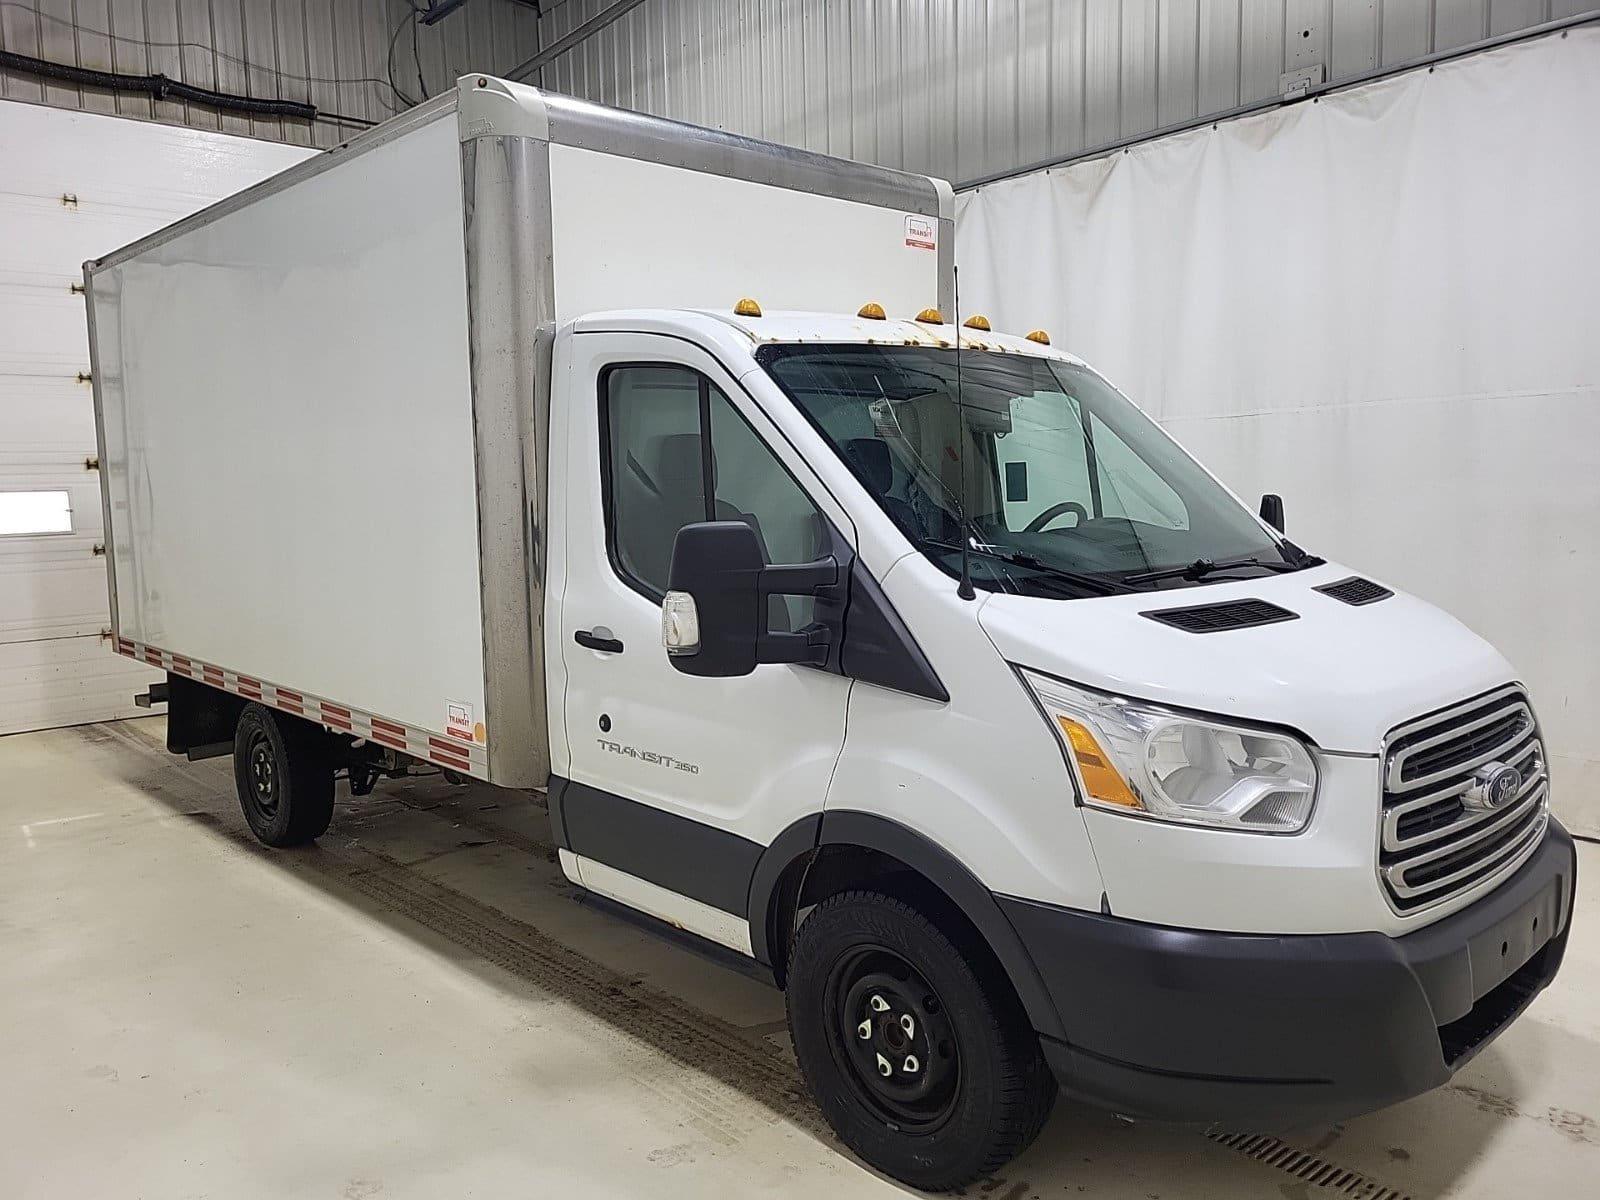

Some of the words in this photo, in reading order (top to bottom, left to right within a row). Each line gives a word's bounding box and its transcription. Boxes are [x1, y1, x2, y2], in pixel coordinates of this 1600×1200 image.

[909, 228, 932, 239] TRANSIT
[449, 714, 470, 727] TRANSIT
[1498, 775, 1518, 802] Ford
